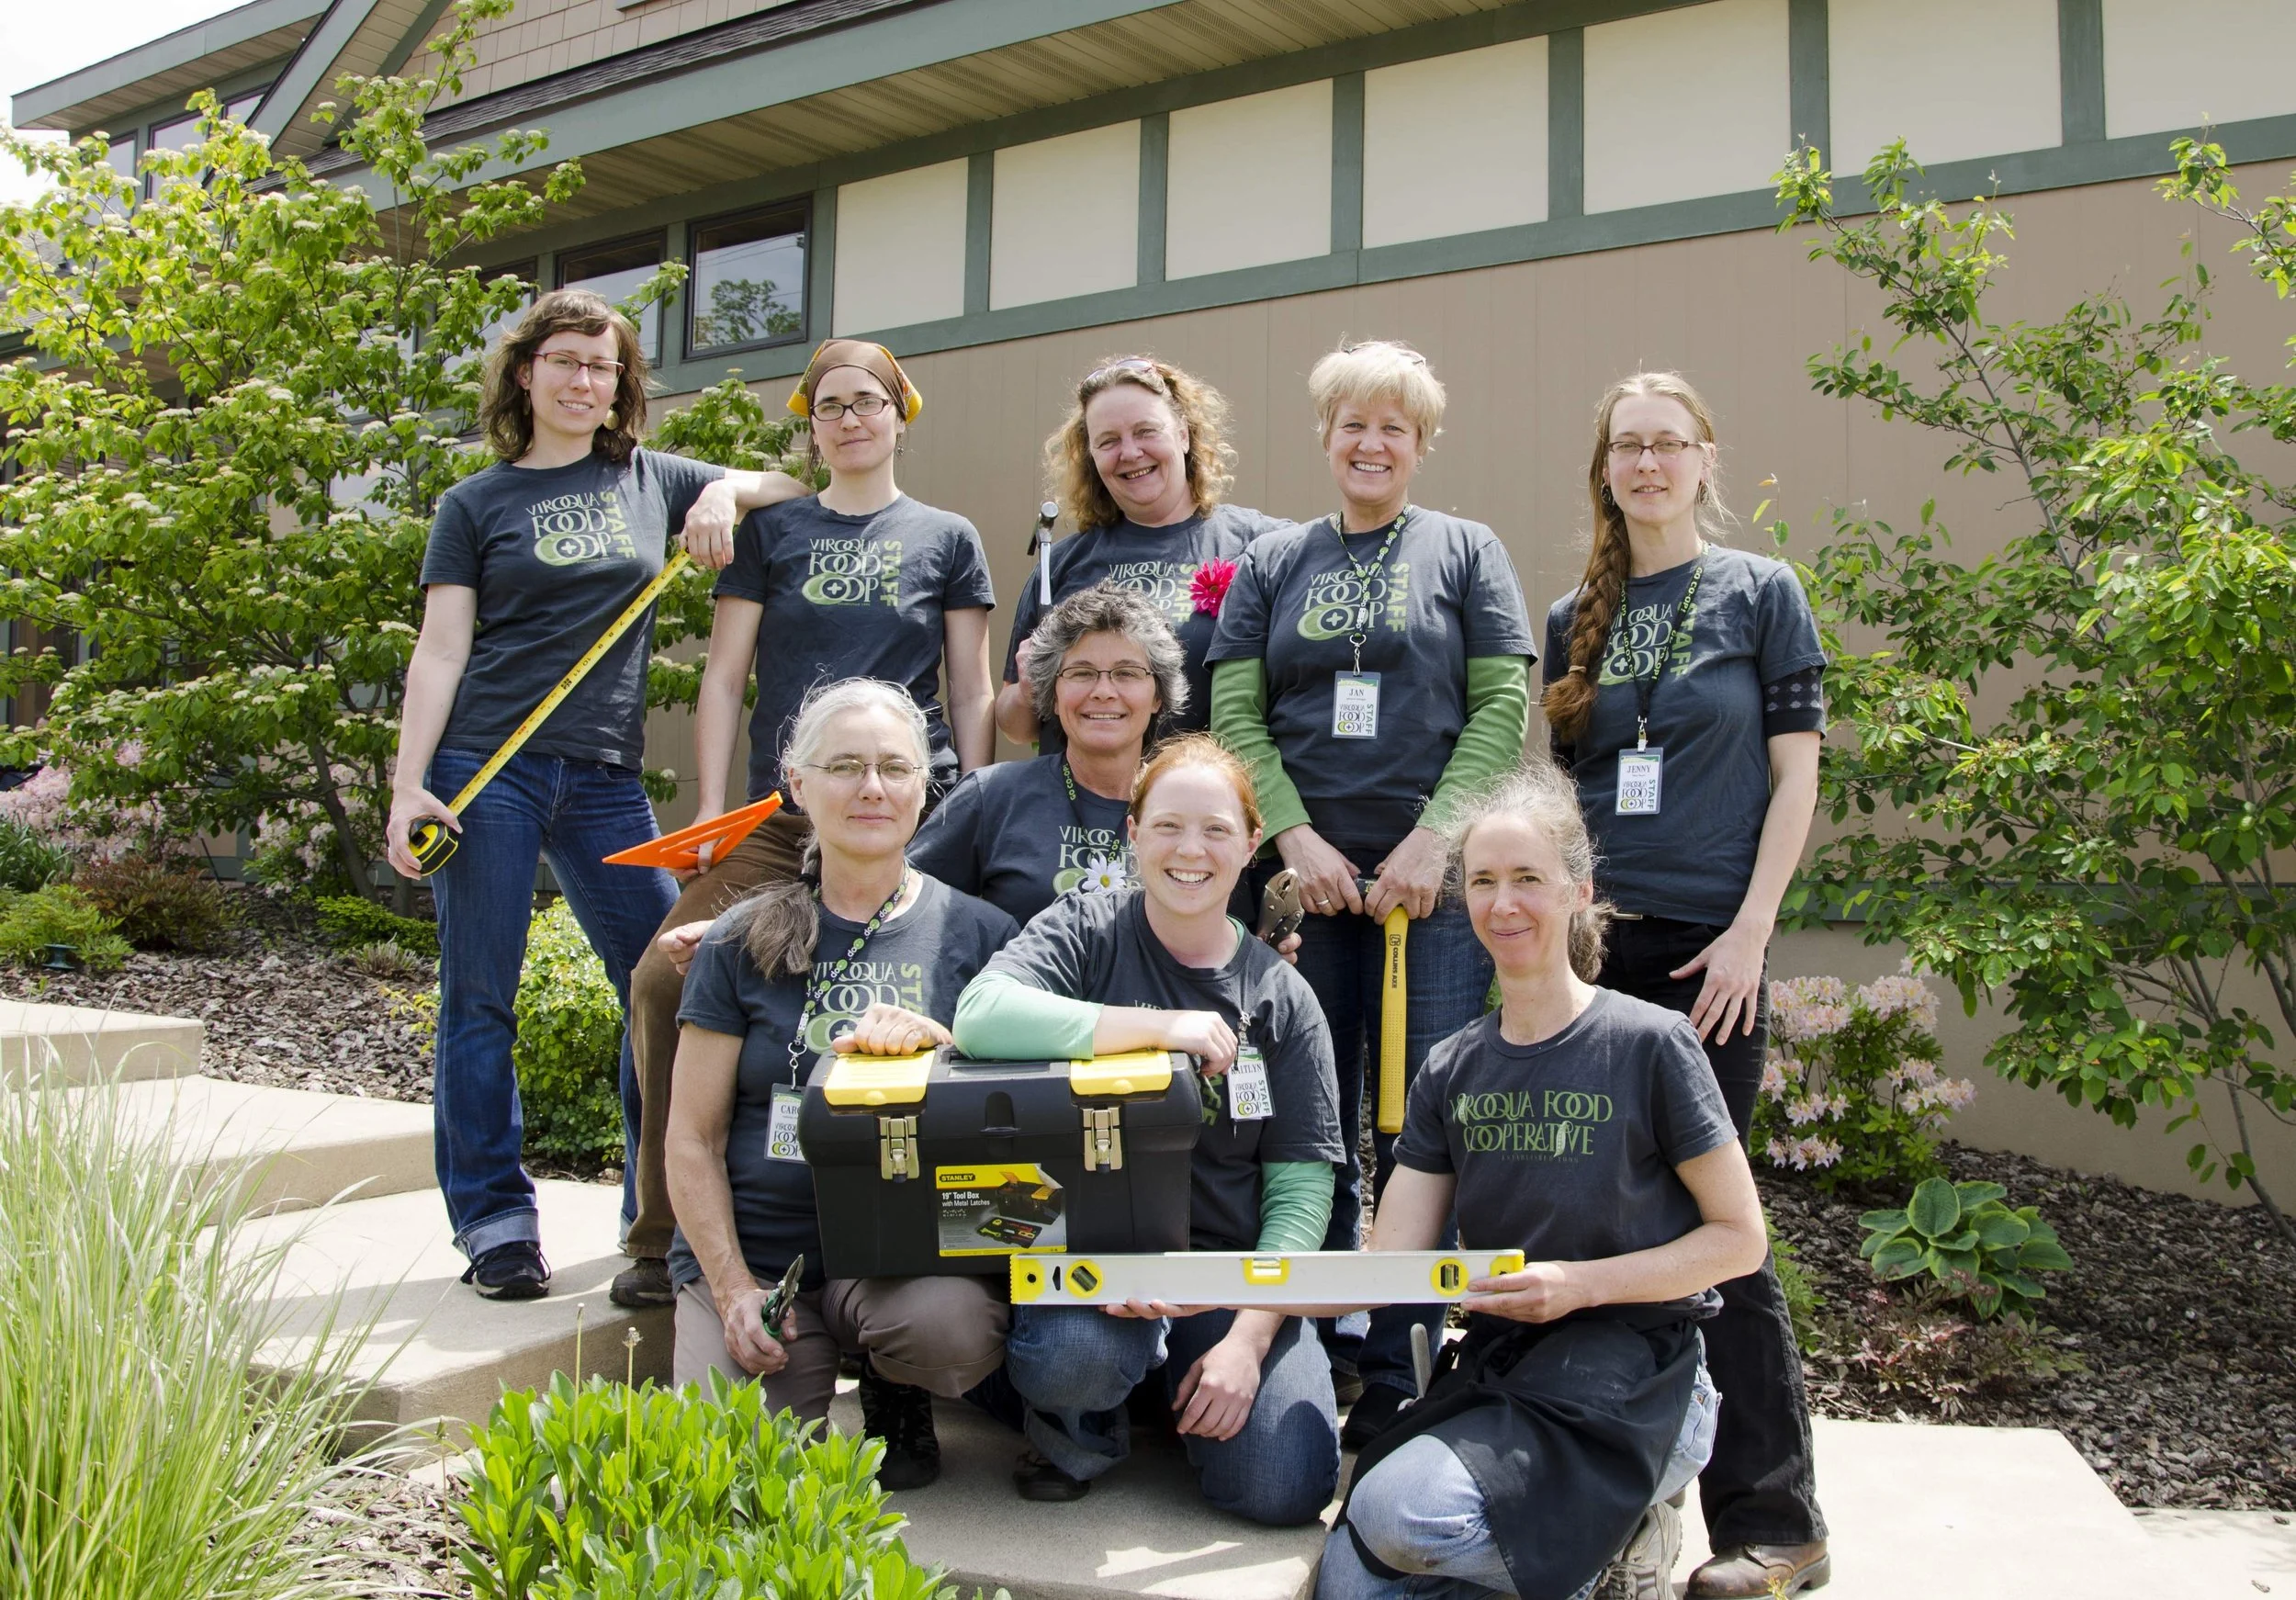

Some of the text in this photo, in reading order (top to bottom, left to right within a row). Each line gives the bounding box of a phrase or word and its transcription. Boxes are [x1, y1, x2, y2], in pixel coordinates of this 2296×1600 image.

[526, 492, 601, 515] VIROQUA
[532, 508, 607, 539] FOOD
[600, 490, 637, 559] STAFF
[809, 538, 881, 556] VIROQUA
[808, 552, 882, 576] FOOD
[880, 540, 903, 606] STAFF
[1109, 561, 1176, 578] VIROQUA
[1385, 562, 1410, 632] STAFF
[1366, 704, 1374, 735] STAFF
[1626, 765, 1650, 773] JENNY
[1648, 779, 1656, 809] STAFF
[1231, 1064, 1262, 1075] KITLYN
[1258, 1080, 1271, 1113] STAFF
[1544, 1090, 1613, 1122] FOOD
[953, 1191, 966, 1200] Tool
